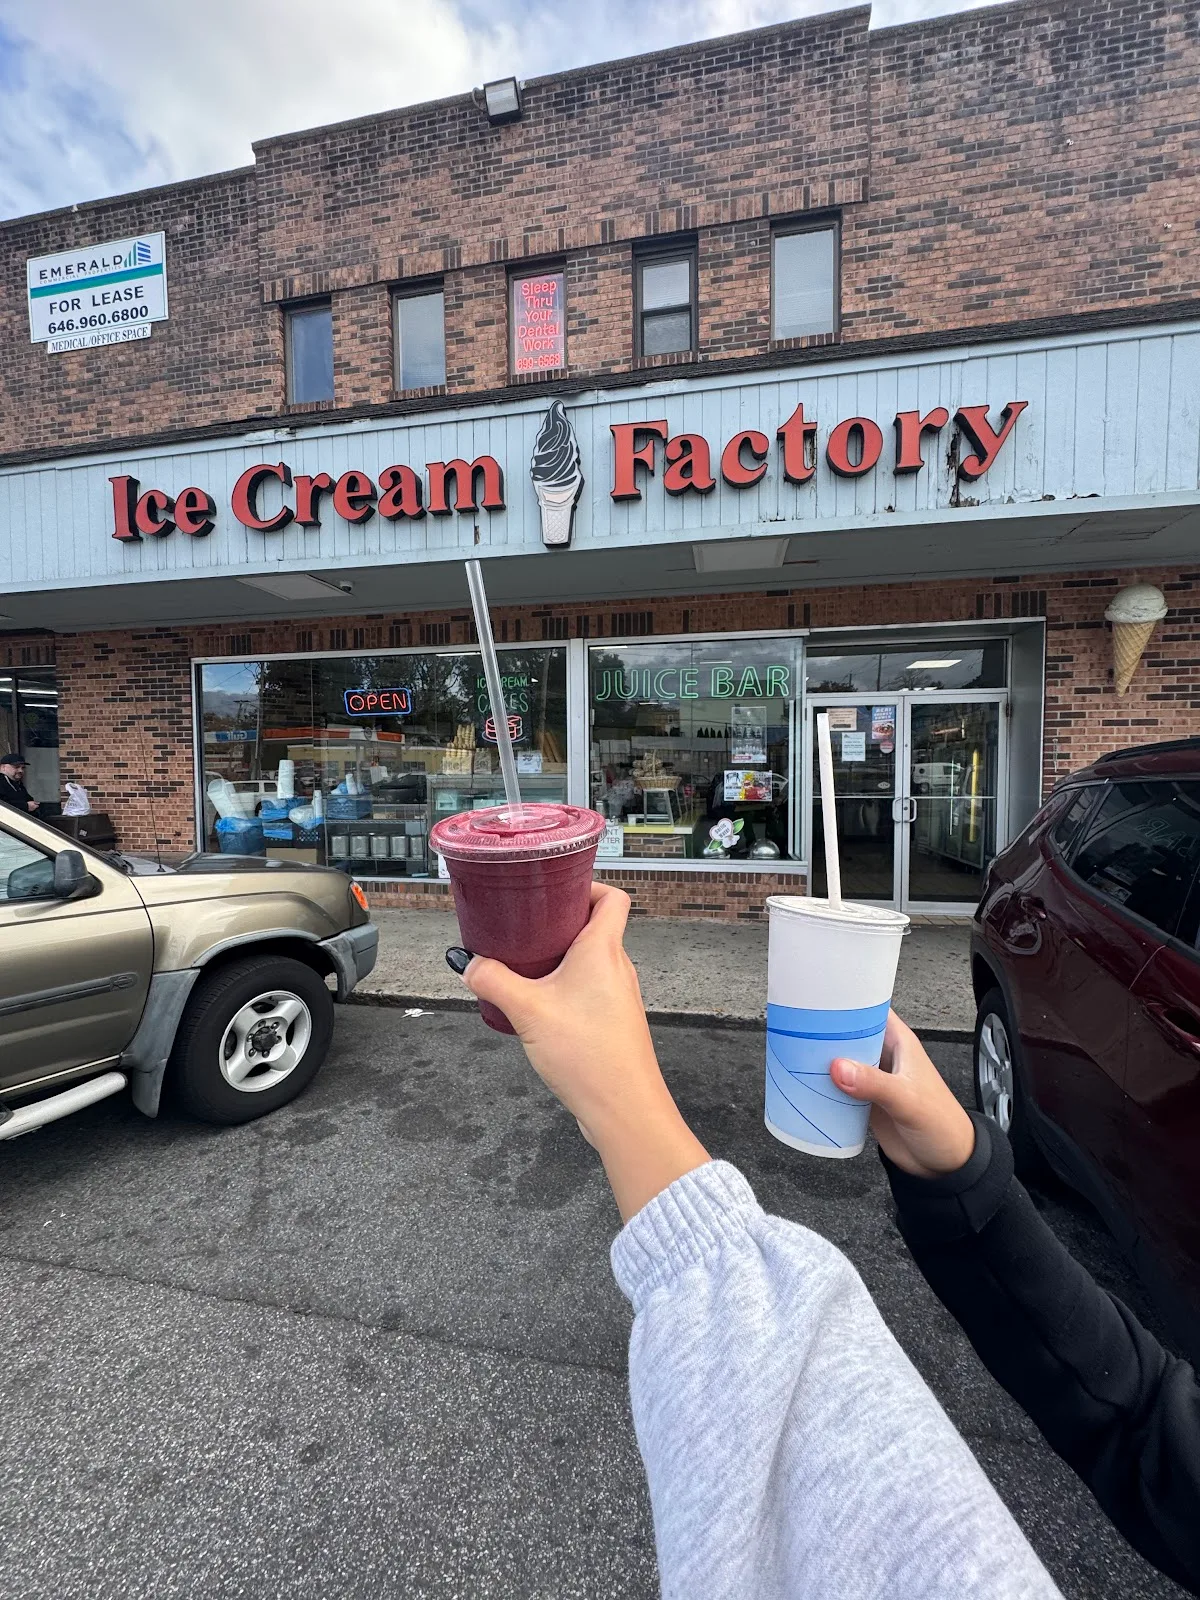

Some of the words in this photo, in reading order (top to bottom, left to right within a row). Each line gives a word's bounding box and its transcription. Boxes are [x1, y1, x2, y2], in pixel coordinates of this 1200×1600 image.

[39, 254, 123, 280] EMERALD
[521, 281, 557, 295] Sleep
[49, 297, 82, 315] FOR
[91, 285, 144, 307] LEASE
[525, 295, 553, 309] Thru
[48, 305, 149, 334] 646.960.6800
[525, 309, 553, 323] Your
[121, 326, 148, 341] SPACE
[518, 322, 560, 338] Dental
[522, 338, 554, 352] Work
[108, 474, 217, 543] Ice
[231, 455, 507, 532] Cream
[610, 400, 1029, 502] Factory
[500, 676, 529, 689] REAM
[596, 668, 699, 700] JUICE
[711, 665, 790, 698] BAR
[349, 693, 407, 711] OPEN
[477, 692, 529, 712] CKES
